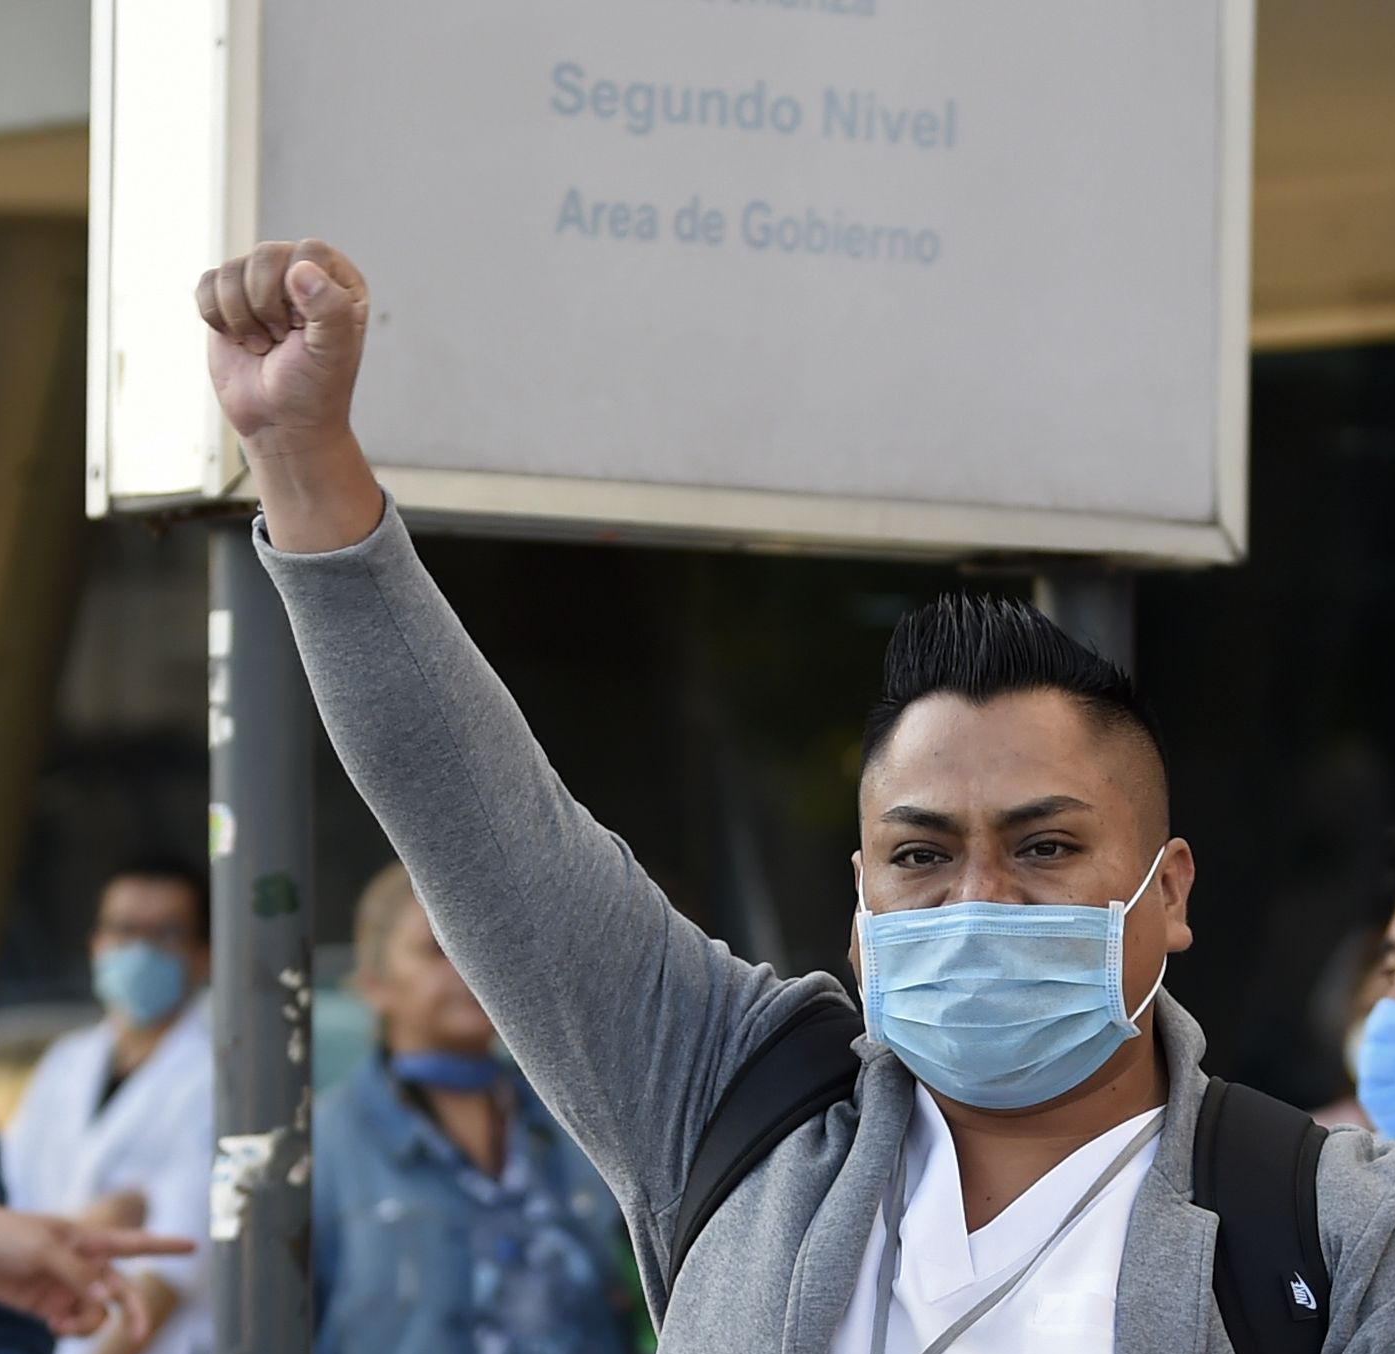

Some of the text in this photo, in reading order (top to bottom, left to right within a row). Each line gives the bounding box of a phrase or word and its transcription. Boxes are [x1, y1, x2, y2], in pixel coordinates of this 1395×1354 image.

[548, 61, 959, 150] Segundo Nivel
[556, 186, 941, 266] Area de Gobierno
